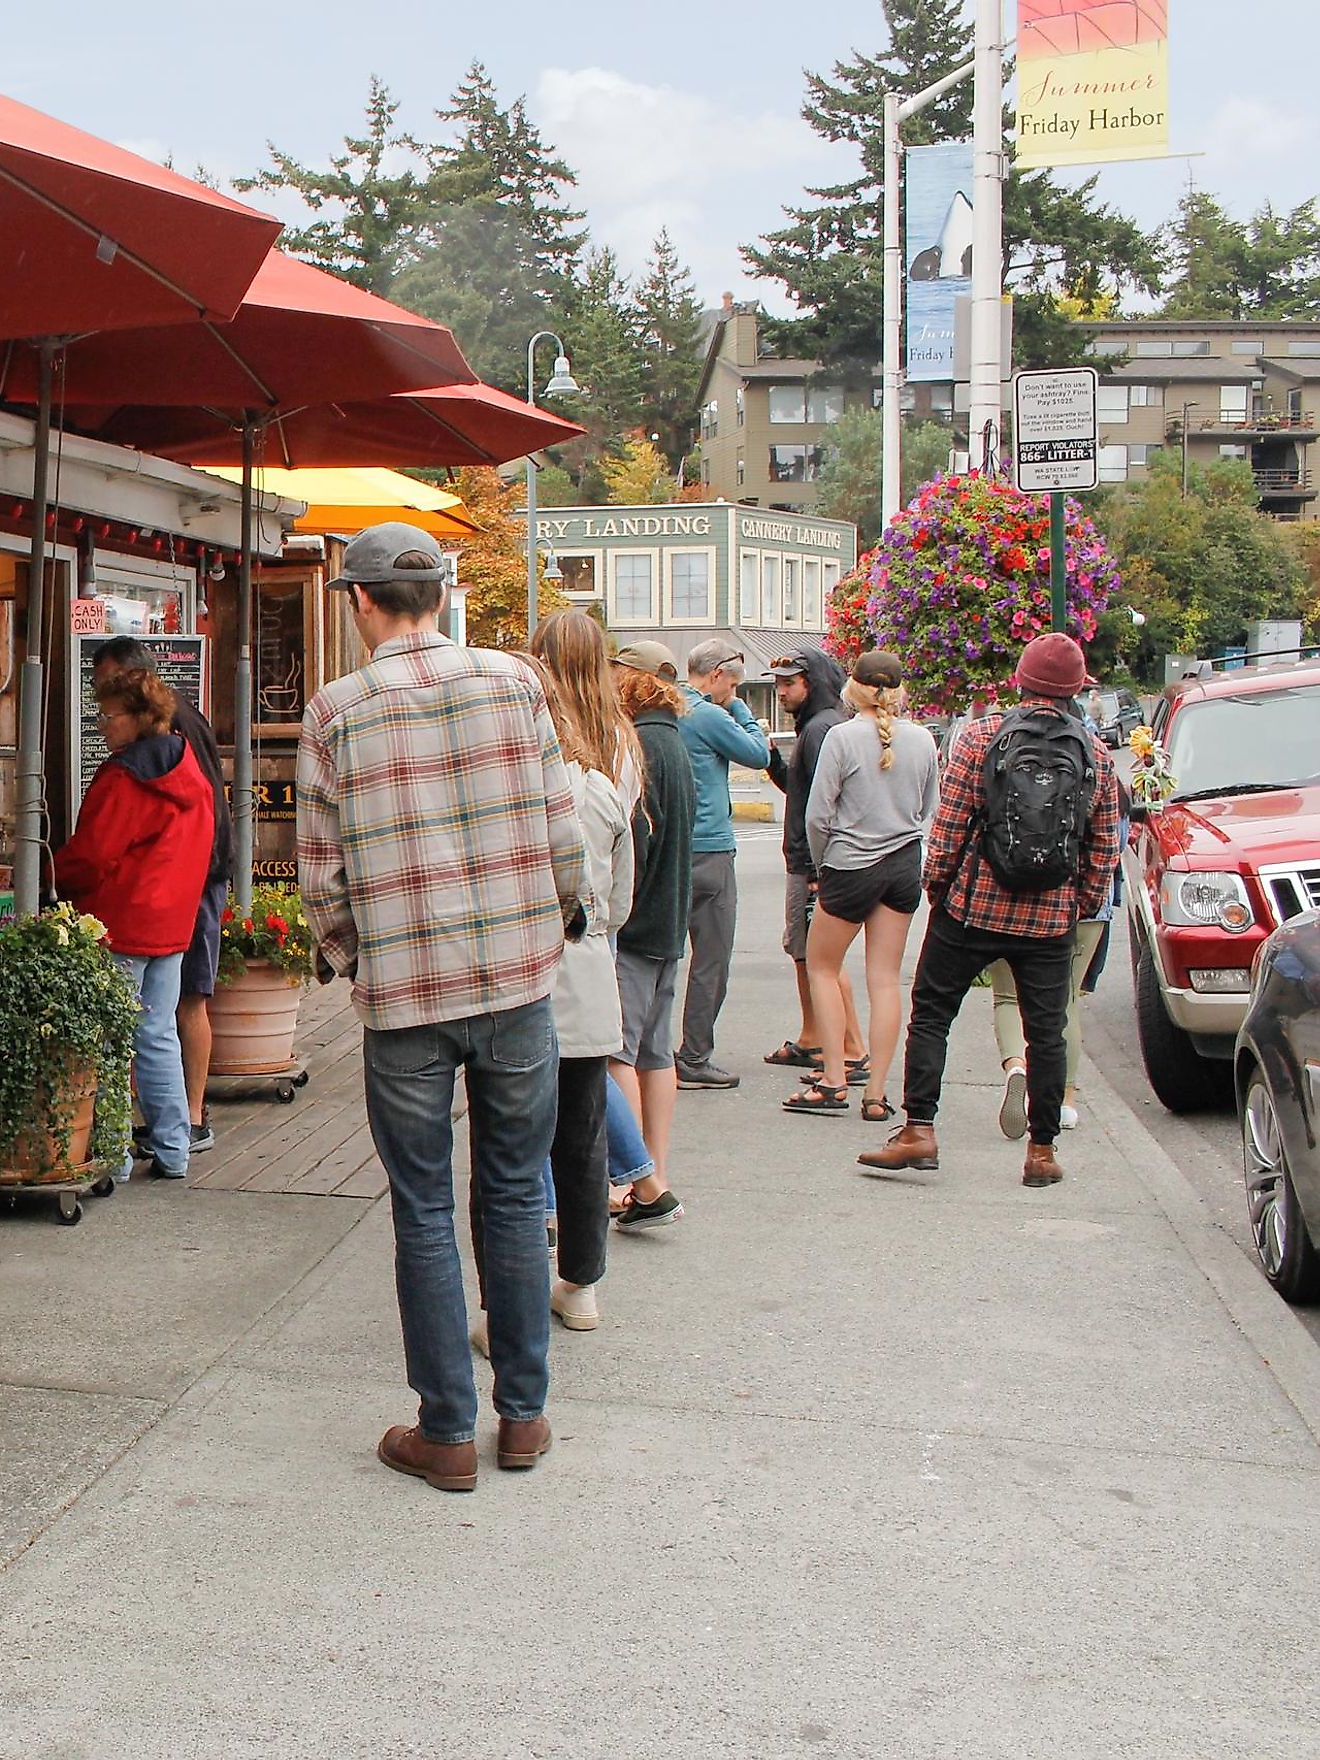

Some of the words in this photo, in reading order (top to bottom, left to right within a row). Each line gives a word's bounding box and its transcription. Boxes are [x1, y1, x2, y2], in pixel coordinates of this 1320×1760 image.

[1020, 70, 1160, 107] Summer
[1020, 113, 1080, 140] Friday
[1089, 106, 1164, 130] Harbor
[919, 323, 954, 341] Sum
[910, 346, 944, 363] Friday
[1020, 443, 1050, 452] REPORT
[1048, 449, 1094, 461] LITTER-1
[584, 516, 711, 538] LANDING
[741, 518, 792, 544] CANNERY
[796, 527, 841, 550] LANDING
[75, 605, 103, 617] CASH
[74, 618, 104, 630] ONLY!
[282, 785, 294, 804] 1
[252, 861, 296, 876] ACCESS
